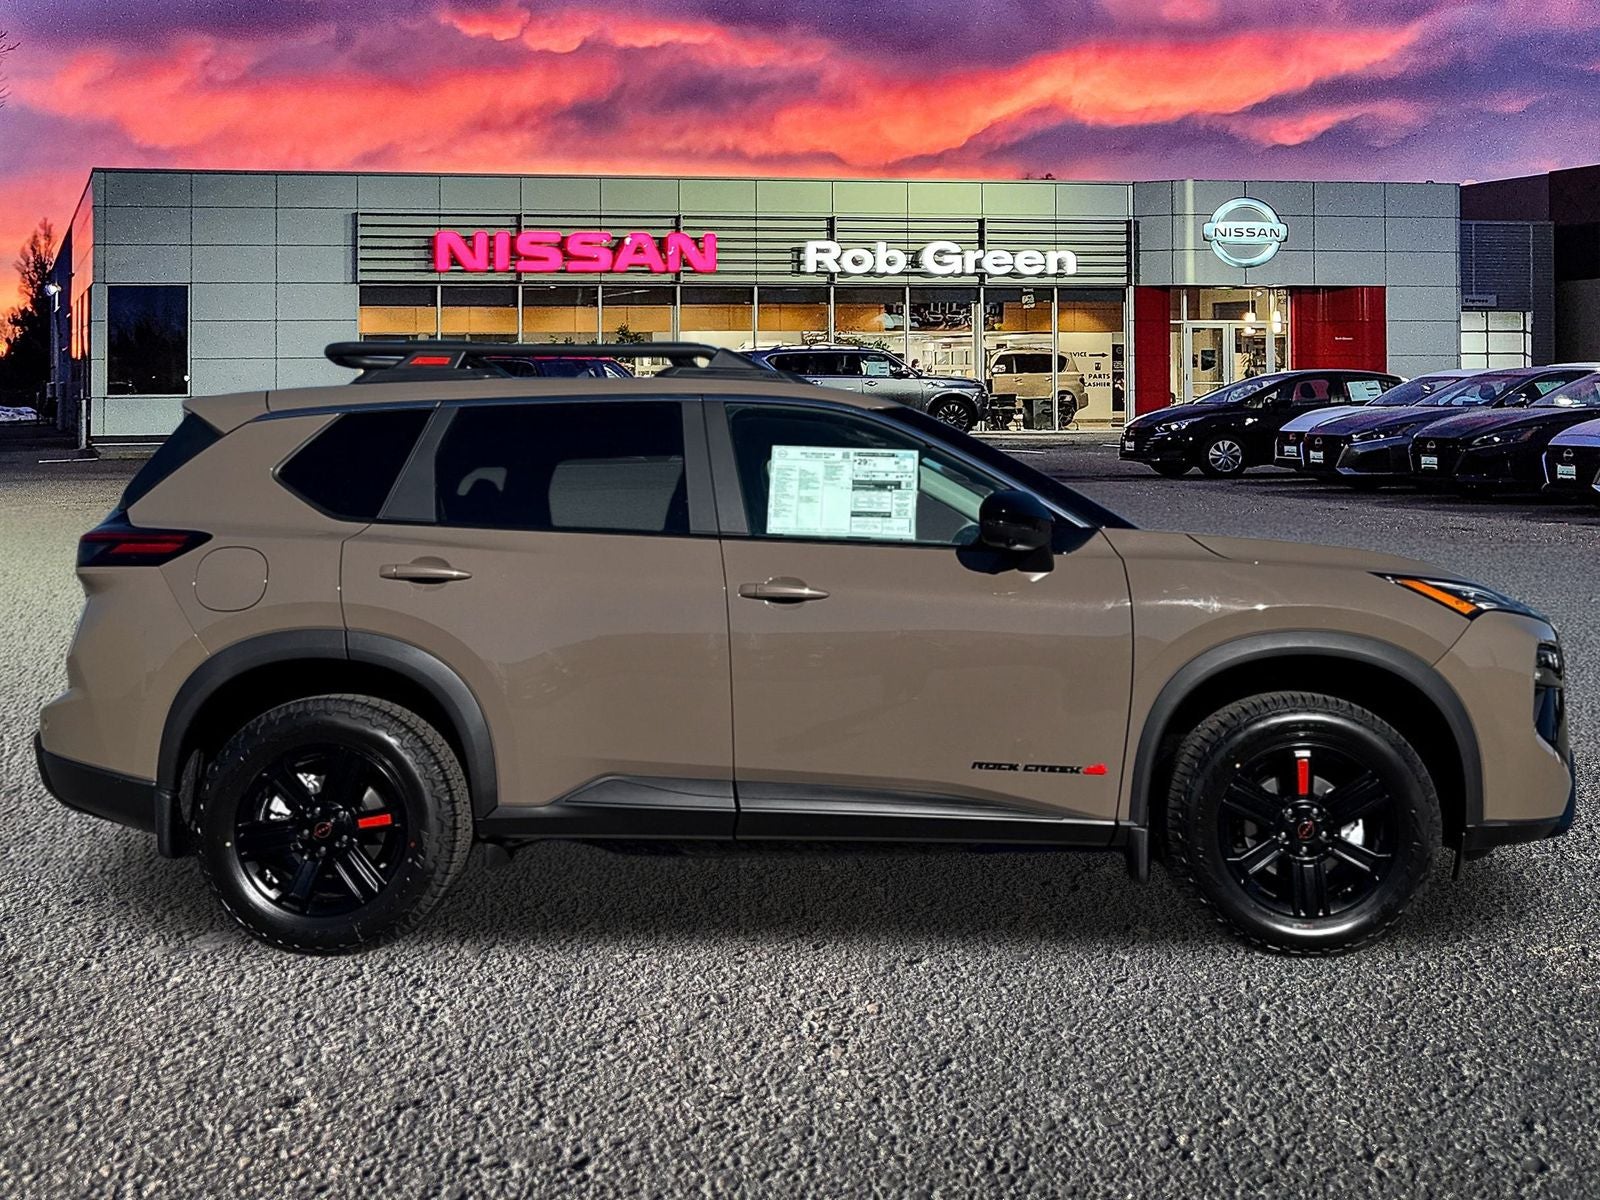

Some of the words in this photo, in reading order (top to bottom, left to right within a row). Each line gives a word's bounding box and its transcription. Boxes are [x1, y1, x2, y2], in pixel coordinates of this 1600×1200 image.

[1214, 227, 1280, 238] NISSAN
[433, 230, 718, 273] NISSAN
[805, 240, 907, 275] Rob
[920, 241, 1078, 275] Green
[971, 761, 1020, 772] ROCK
[1022, 764, 1083, 774] CREEK
